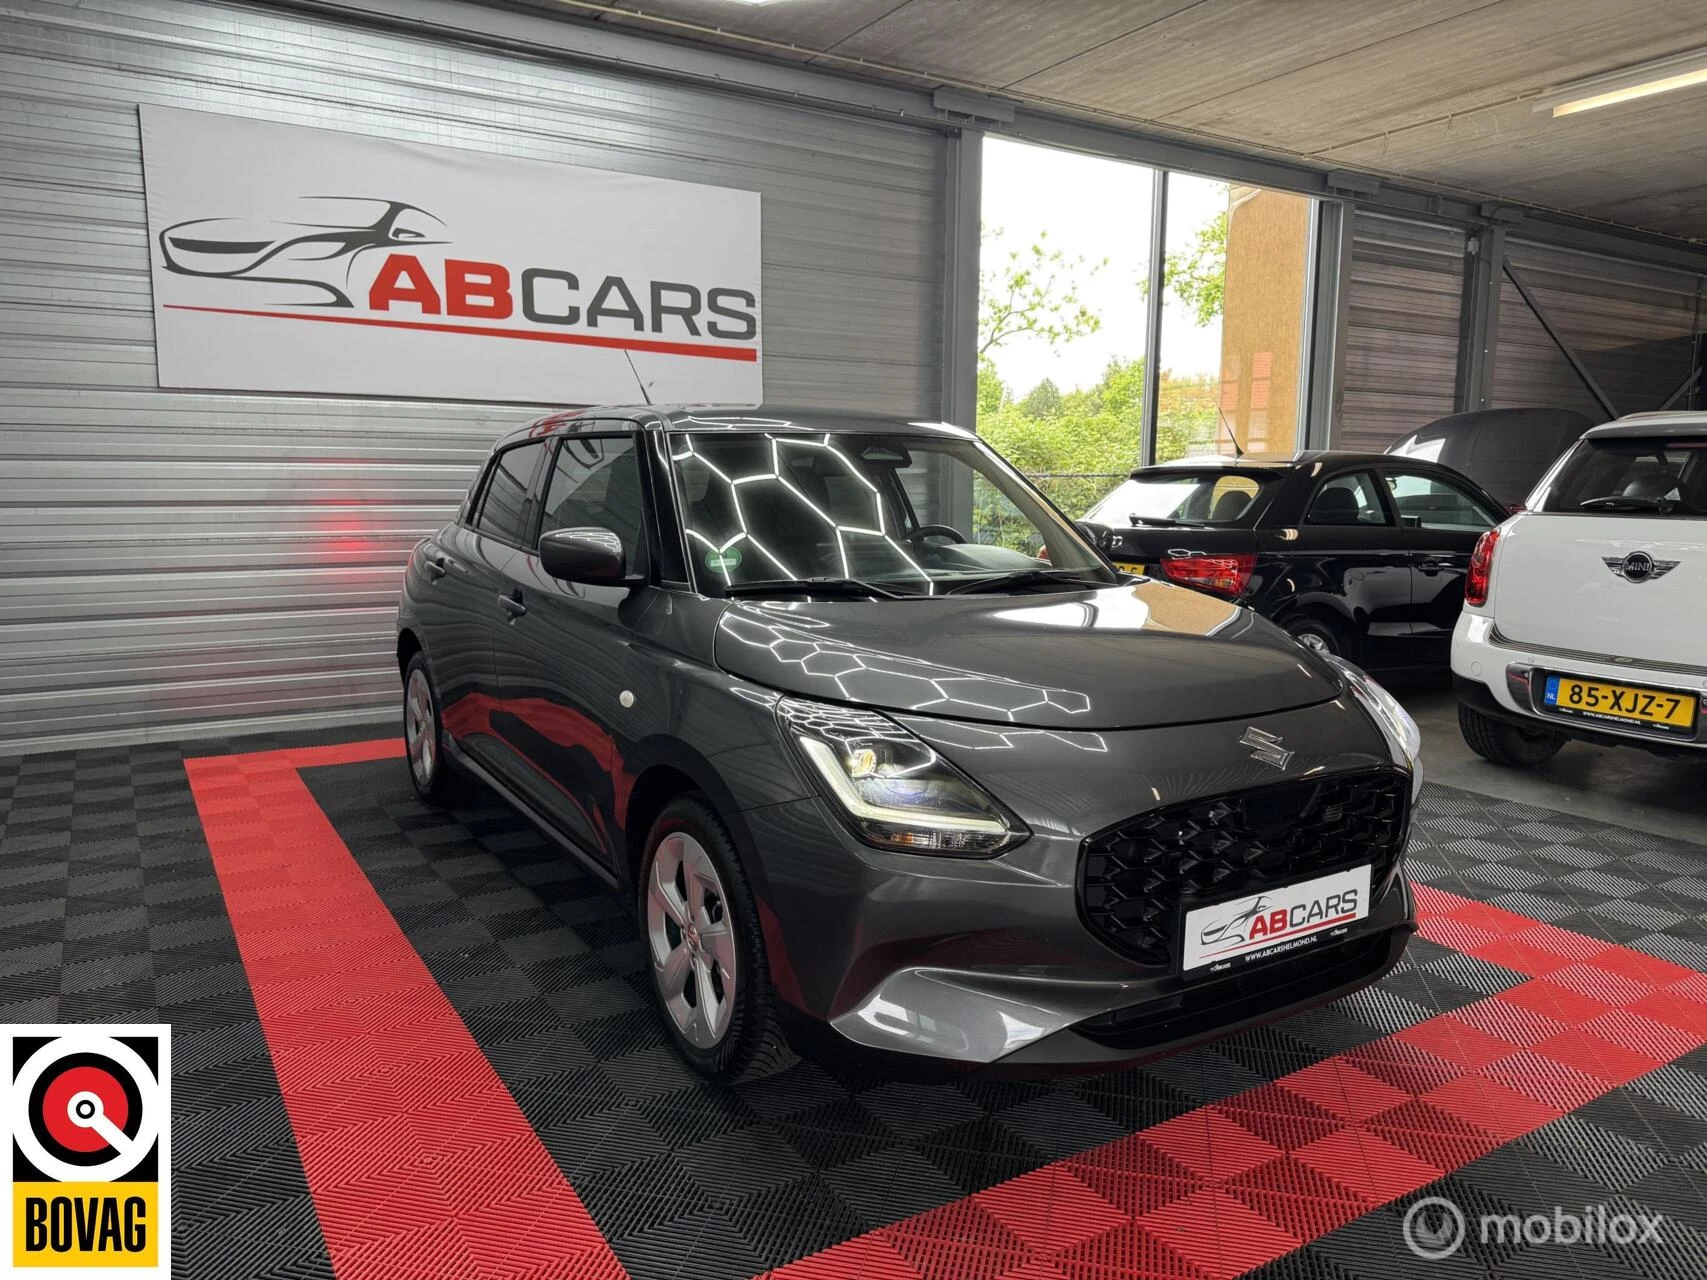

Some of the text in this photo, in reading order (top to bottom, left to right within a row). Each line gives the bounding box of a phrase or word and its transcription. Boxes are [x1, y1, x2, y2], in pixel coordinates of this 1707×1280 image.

[368, 253, 757, 340] ABCARS
[1625, 561, 1650, 571] MINI
[1546, 692, 1556, 700] NL
[1568, 684, 1681, 719] 85-XJZ-7
[1248, 889, 1358, 940] ABCARS
[1245, 935, 1318, 962] WWW.ABCARSHELMOND.NL
